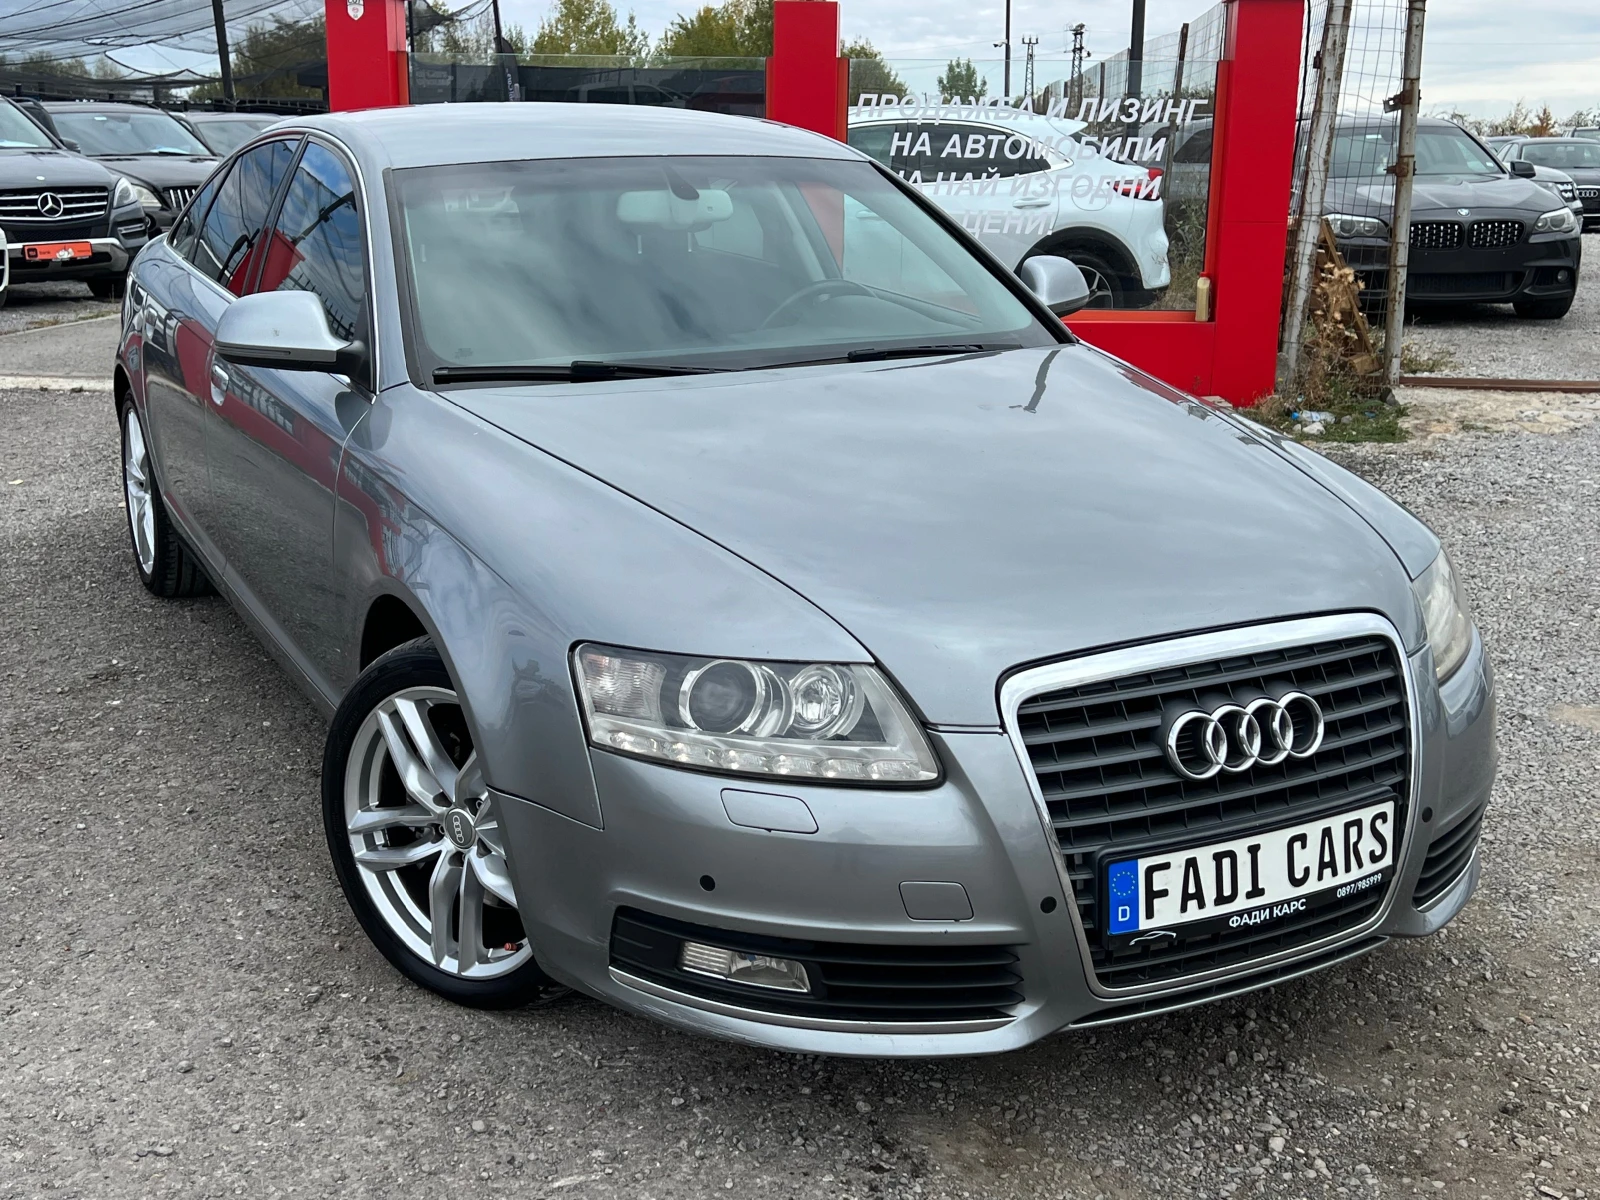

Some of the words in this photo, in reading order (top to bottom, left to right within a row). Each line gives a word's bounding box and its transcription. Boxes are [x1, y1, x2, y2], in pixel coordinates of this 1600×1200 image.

[856, 93, 1034, 126] ПРОДАЖБА
[1045, 97, 1070, 122] И
[1075, 98, 1208, 123] ЛИЗИНГ
[889, 132, 932, 156] НА
[940, 133, 1167, 161] АВТОМОБИЛИ
[899, 170, 923, 191] А
[933, 167, 1000, 197] НАЙ
[1008, 173, 1162, 204] ИЗГОДНИ
[962, 210, 1058, 239] ЦЕНИ!
[1145, 844, 1265, 920] FADI
[1286, 811, 1389, 888] CARS
[1336, 873, 1382, 899] 0897/985999
[1118, 906, 1130, 921] D
[1228, 908, 1271, 928] ФАДИ
[1273, 899, 1307, 918] КАРС
